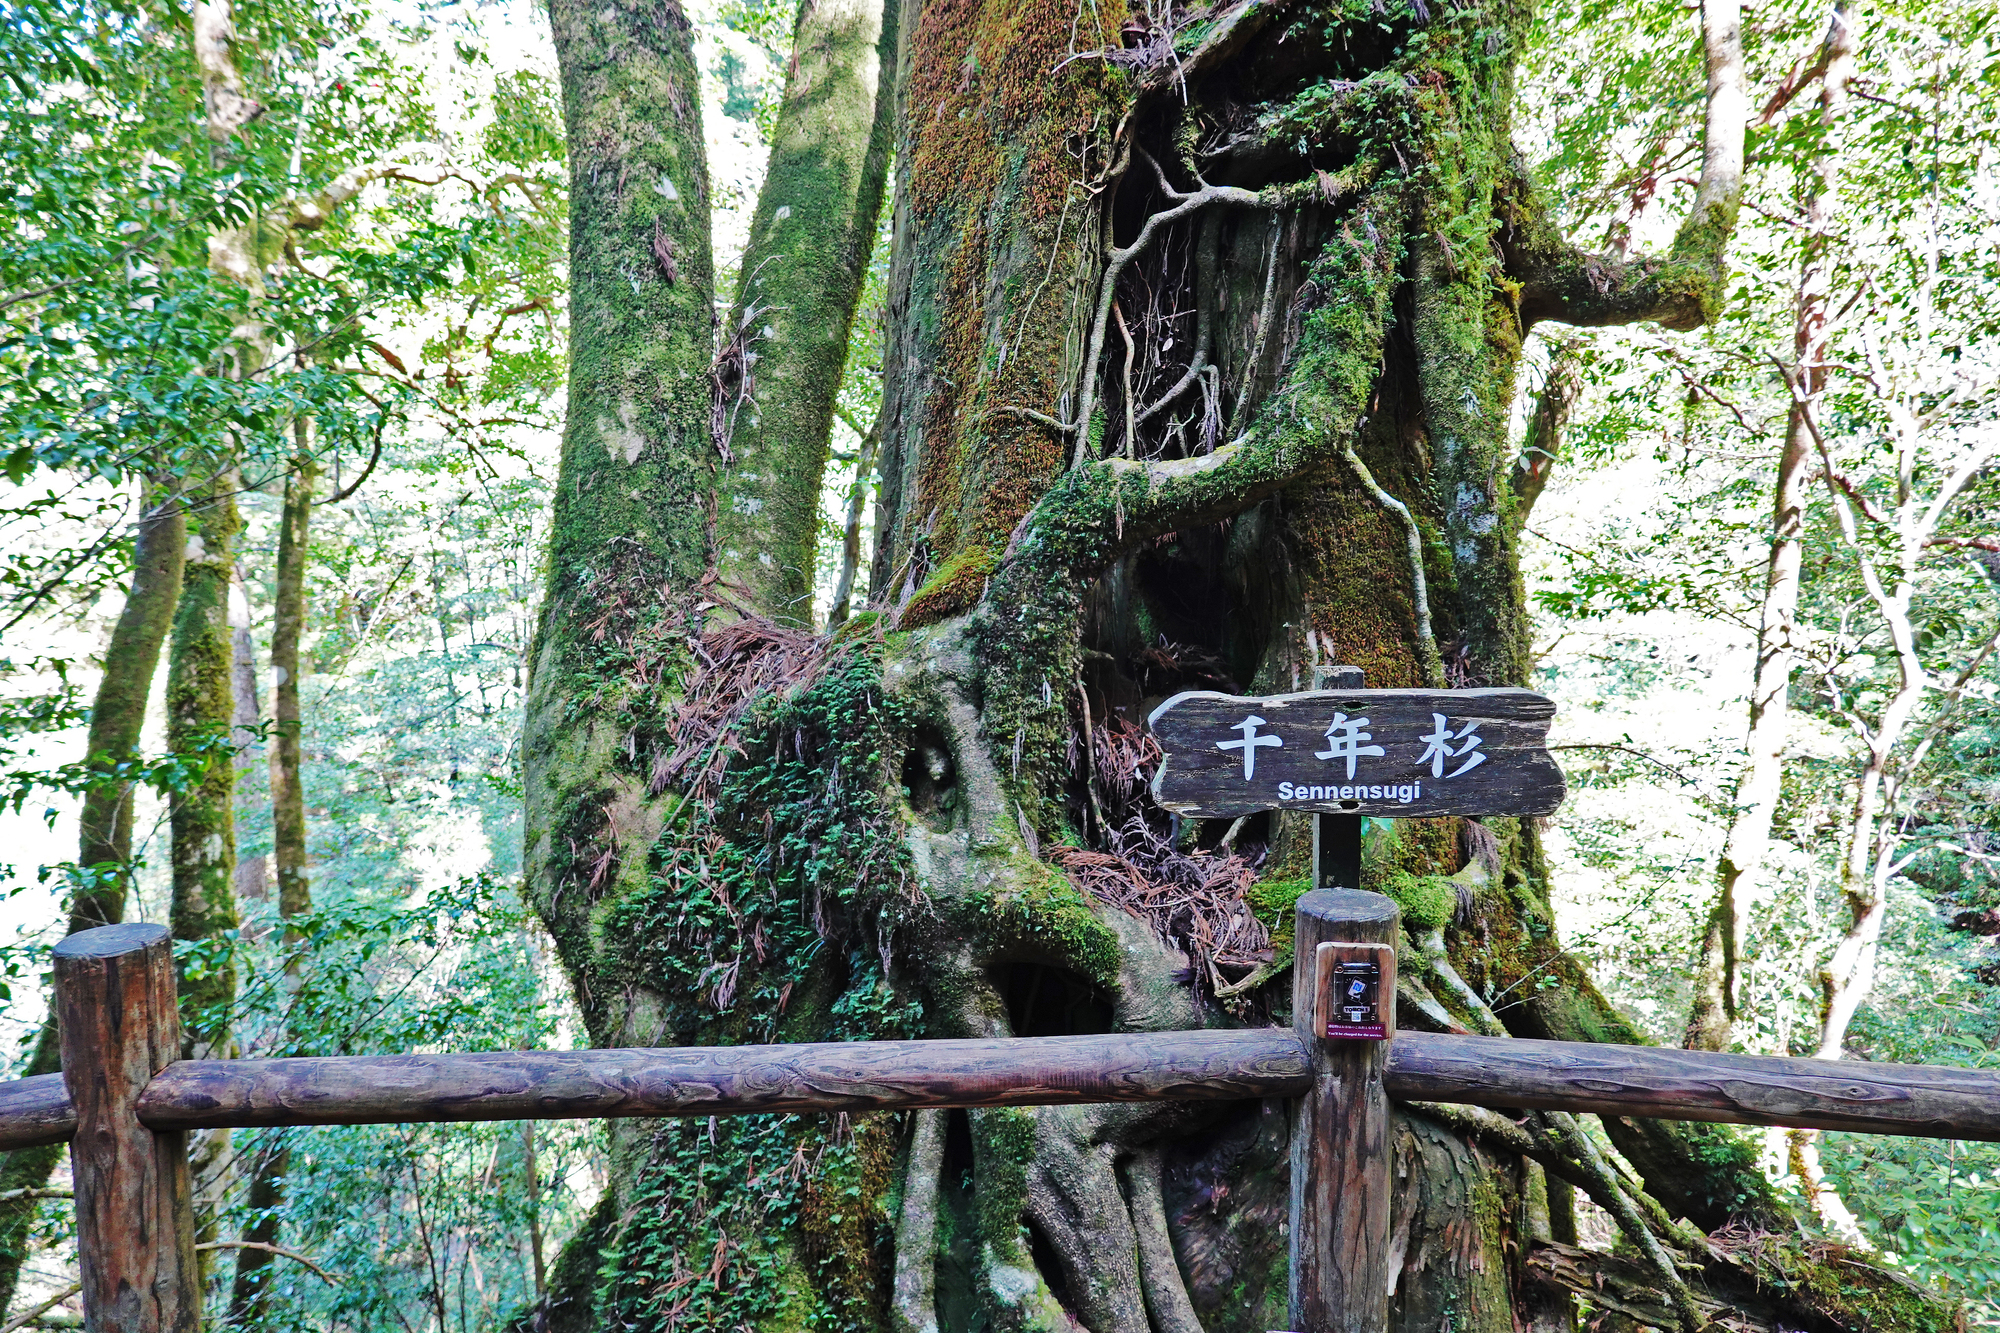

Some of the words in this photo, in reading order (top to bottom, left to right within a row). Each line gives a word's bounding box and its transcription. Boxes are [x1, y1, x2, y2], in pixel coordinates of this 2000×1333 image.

[1215, 712, 1487, 781] 千年杉
[1278, 781, 1421, 803] Sennensugi
